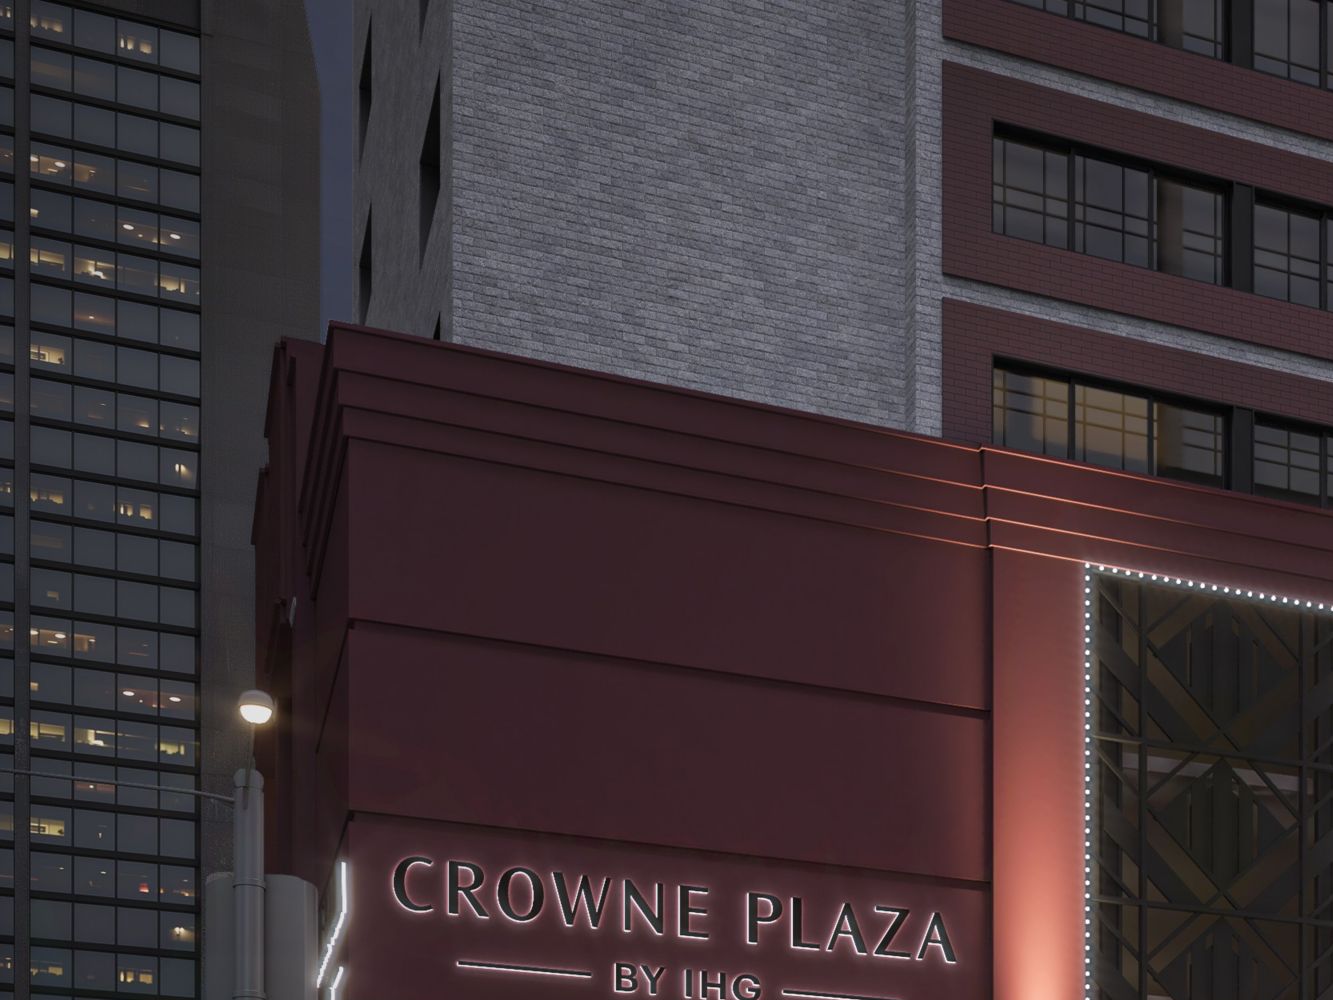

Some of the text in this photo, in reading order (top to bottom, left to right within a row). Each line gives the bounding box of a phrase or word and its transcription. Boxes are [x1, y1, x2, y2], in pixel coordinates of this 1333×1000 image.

[391, 855, 958, 964] CROWNE PLAZA
[613, 962, 666, 996] BY
